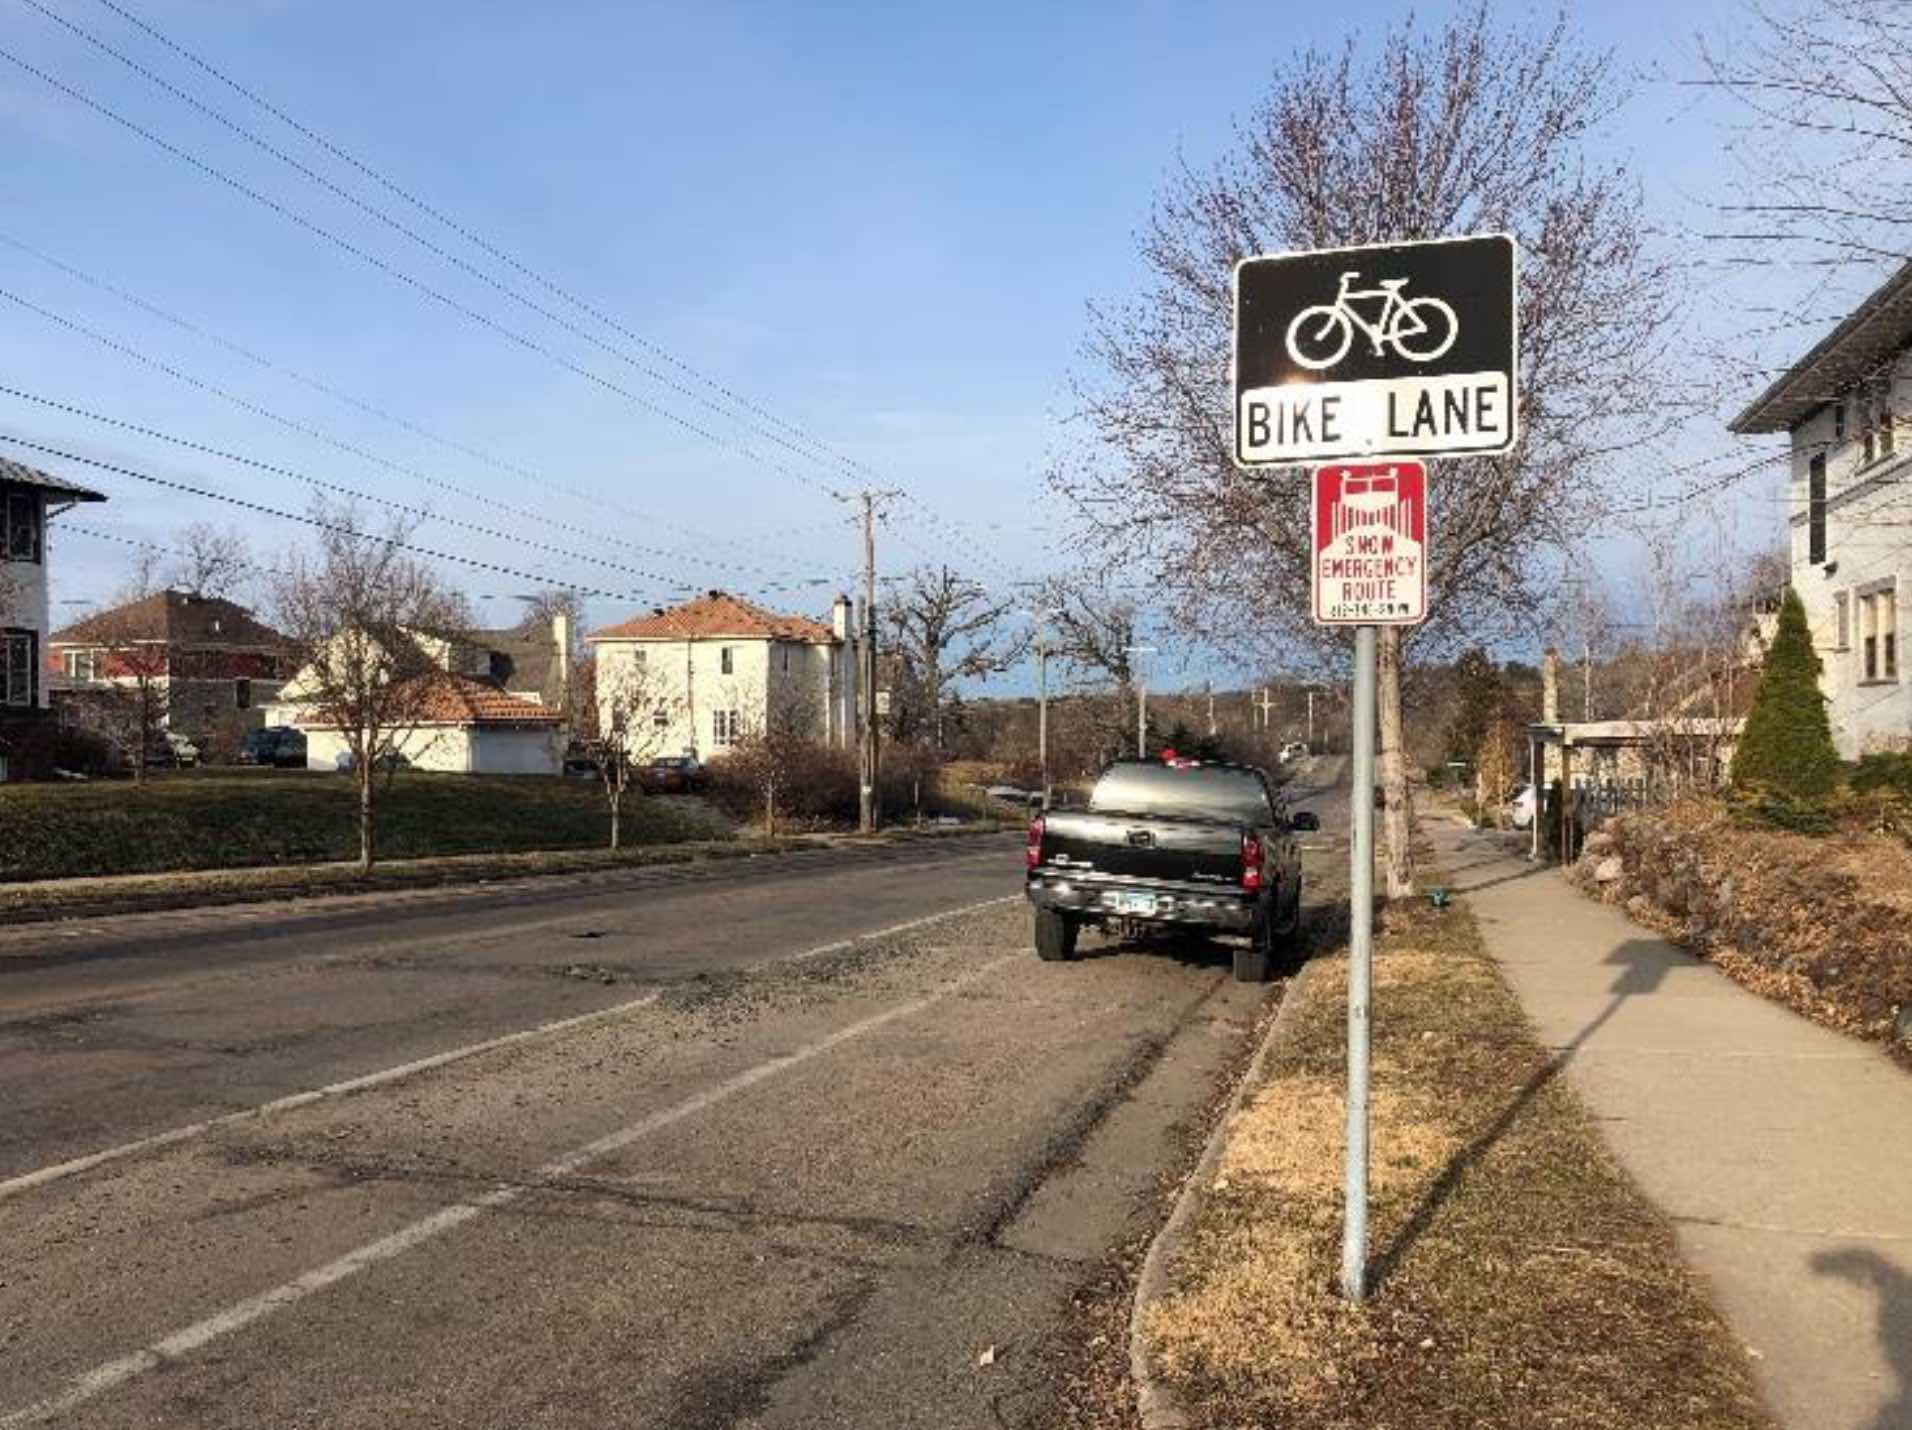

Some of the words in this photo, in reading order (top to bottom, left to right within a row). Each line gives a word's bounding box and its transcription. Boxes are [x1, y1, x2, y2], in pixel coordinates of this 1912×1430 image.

[1248, 396, 1342, 448] BIKE
[1386, 384, 1499, 438] LANE
[1345, 535, 1394, 555] SNOW
[1322, 556, 1417, 578] EMERGENCY
[1342, 579, 1396, 601] ROUTE
